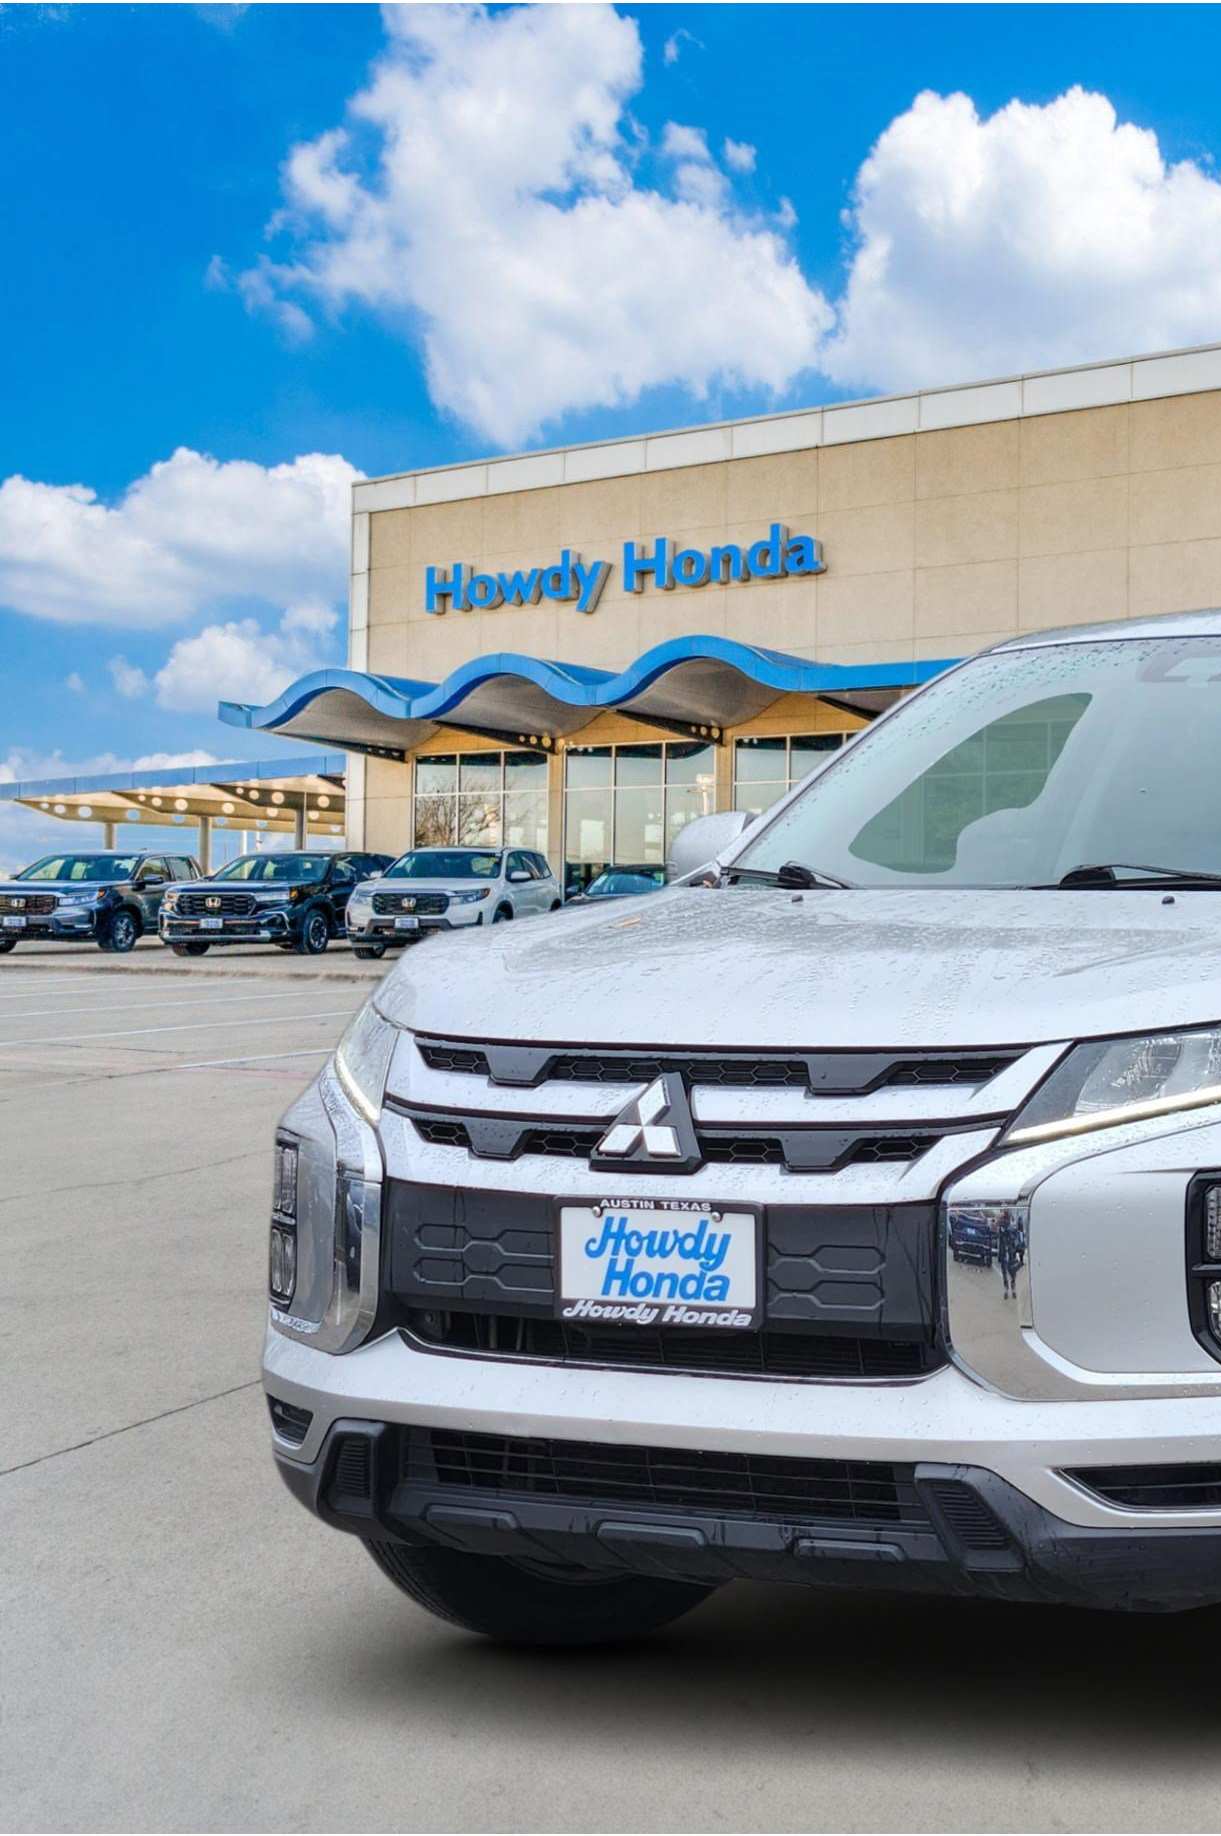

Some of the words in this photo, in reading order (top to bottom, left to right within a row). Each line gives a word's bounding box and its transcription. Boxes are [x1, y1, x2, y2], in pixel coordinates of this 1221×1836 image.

[426, 549, 612, 614] Howdy
[623, 523, 827, 593] Honda
[600, 1199, 655, 1210] AUSTIN
[662, 1201, 712, 1212] TEXAS
[585, 1216, 731, 1271] Howdy
[601, 1258, 730, 1301] Honda
[562, 1300, 660, 1325] Howdy
[662, 1305, 752, 1326] Honda
